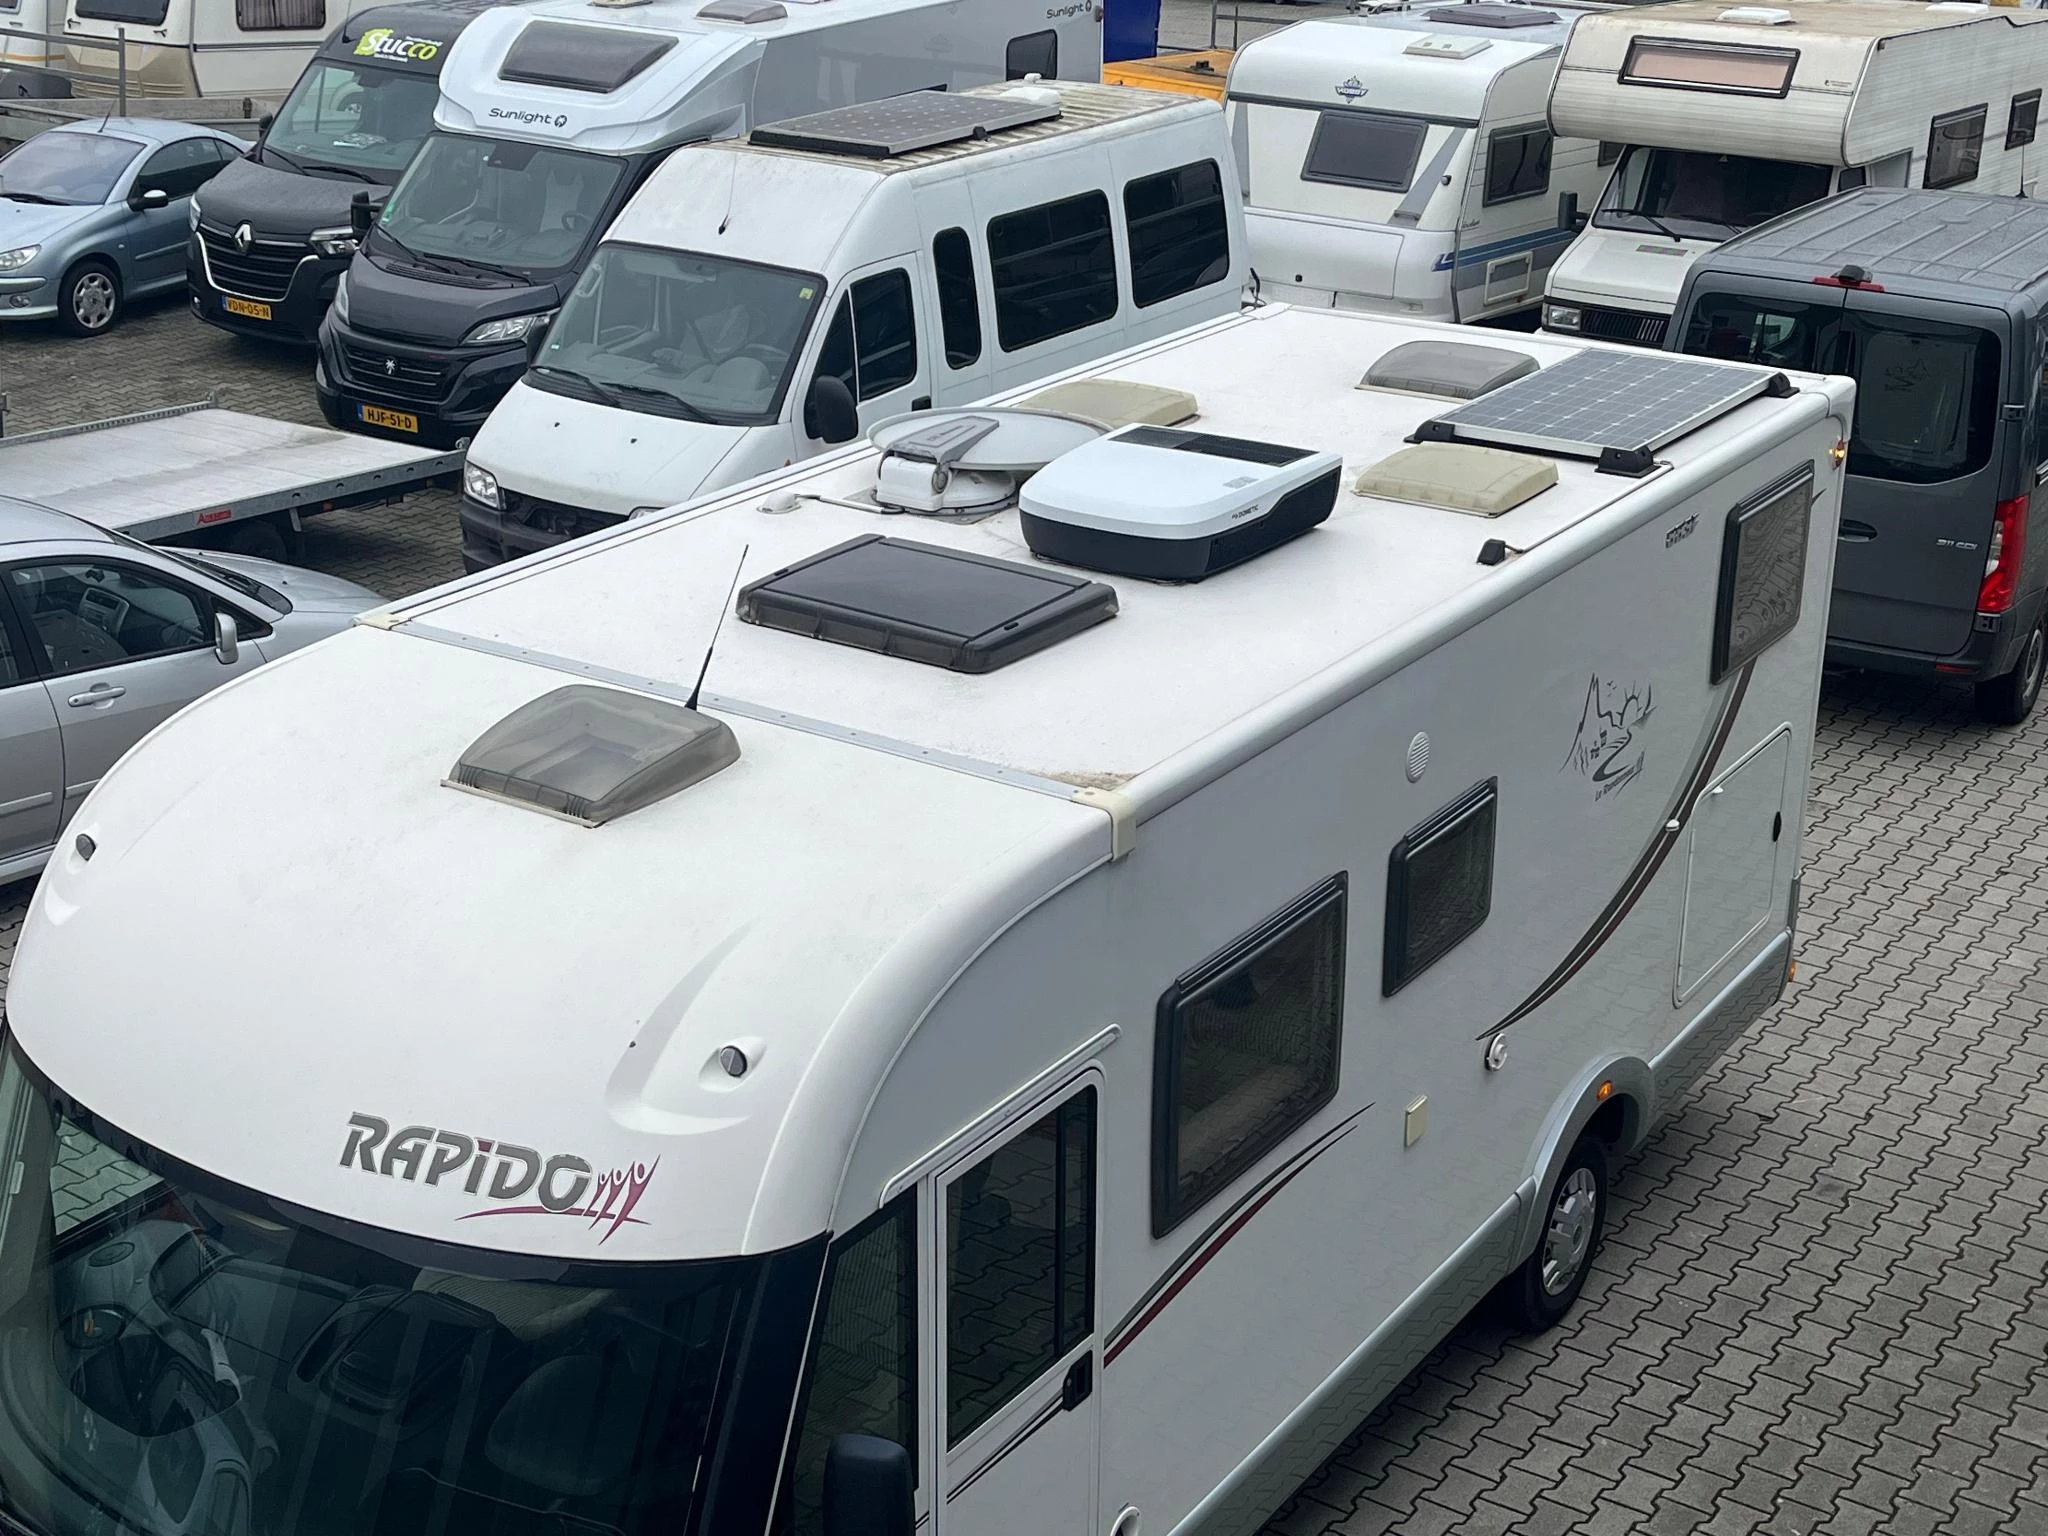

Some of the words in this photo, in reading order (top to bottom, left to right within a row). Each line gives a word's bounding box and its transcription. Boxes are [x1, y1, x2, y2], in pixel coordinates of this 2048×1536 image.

[1046, 3, 1084, 19] Sunlight
[488, 107, 552, 124] Sunlight
[367, 408, 412, 429] HJF-51-D
